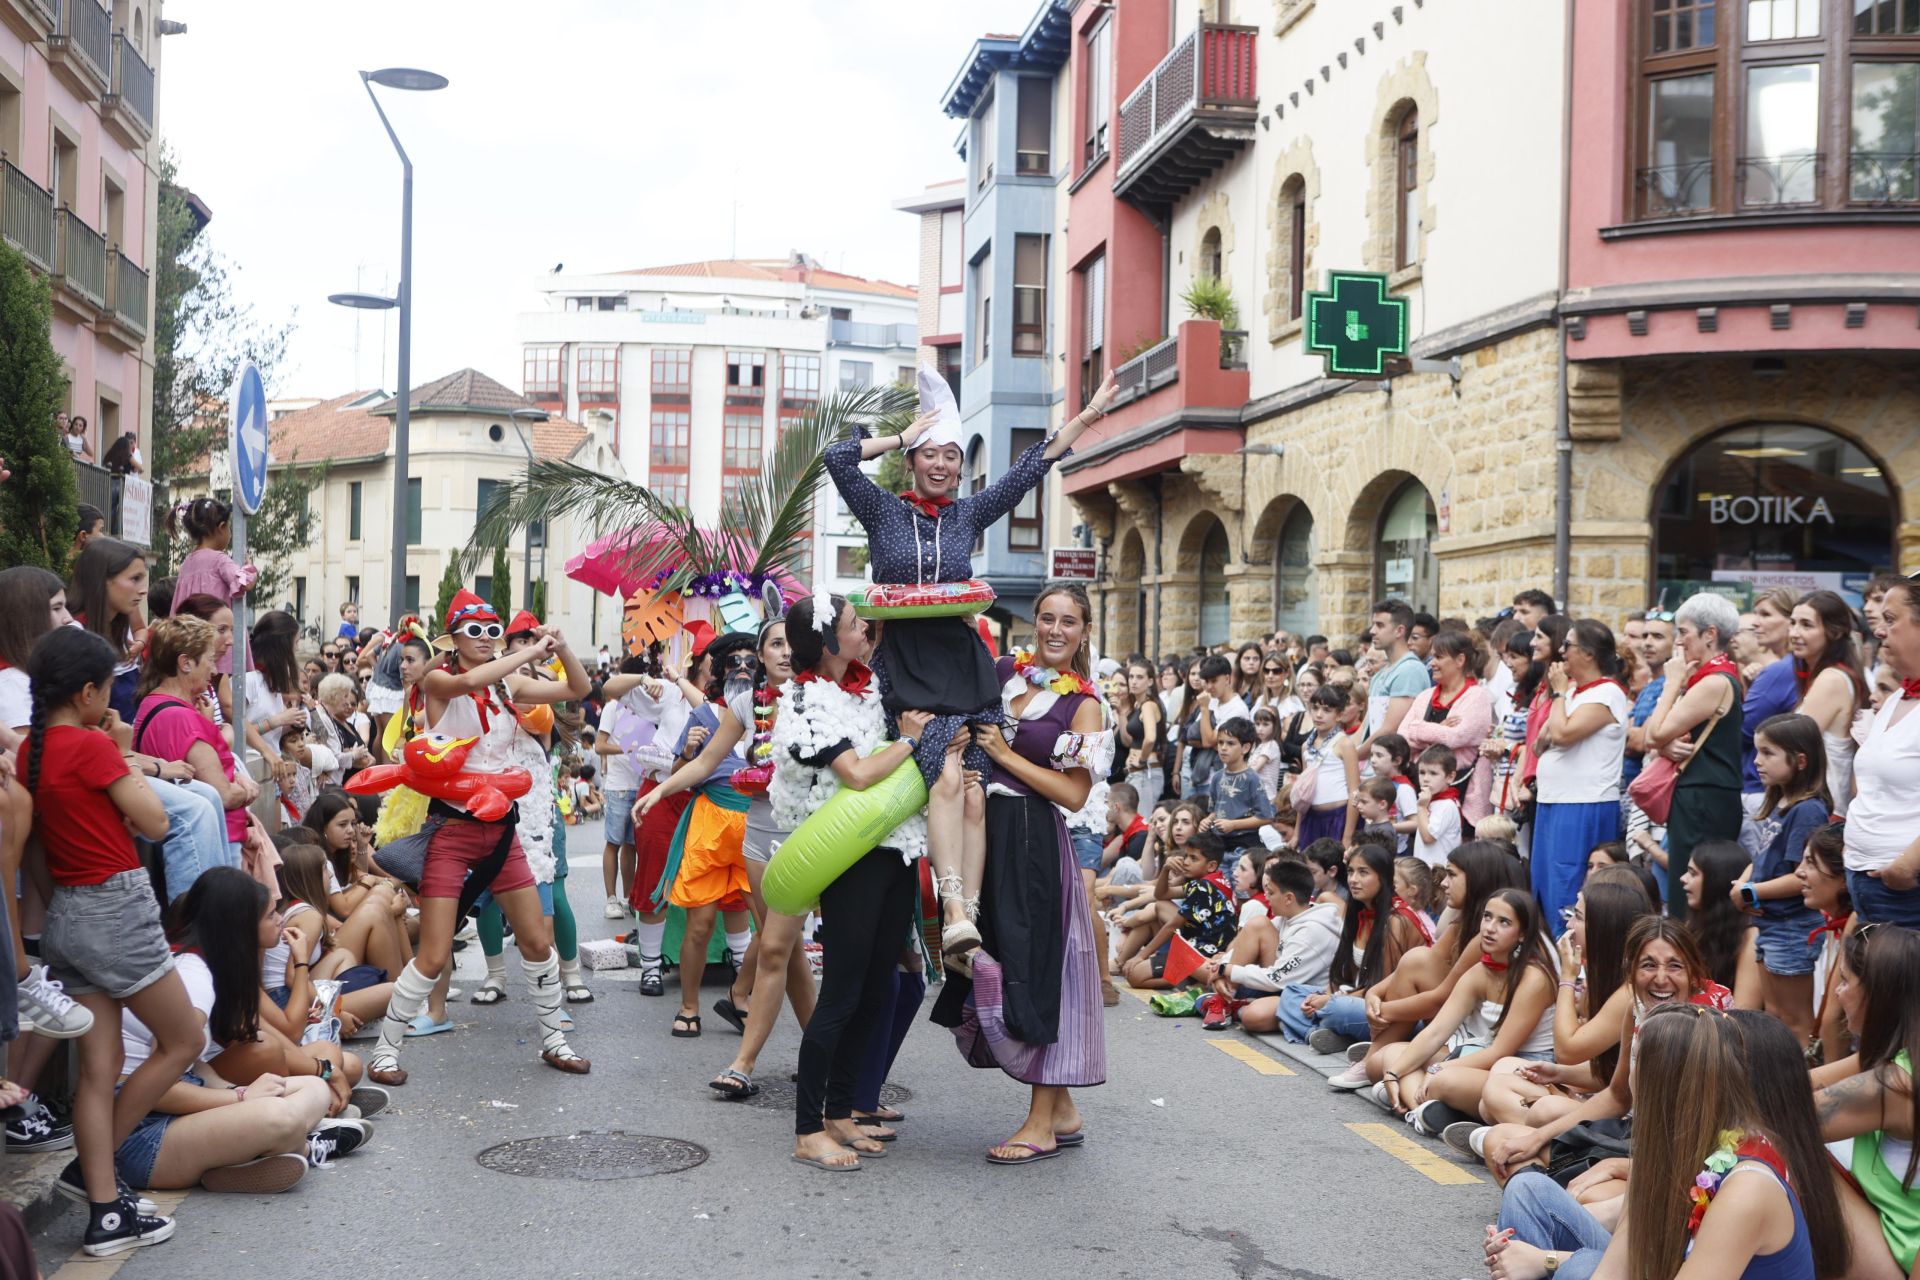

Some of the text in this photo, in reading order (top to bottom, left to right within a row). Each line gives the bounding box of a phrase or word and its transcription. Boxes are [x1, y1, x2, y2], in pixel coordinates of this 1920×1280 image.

[1710, 496, 1835, 524] BOTIKA
[1740, 575, 1815, 585] SIN INSECTOS
